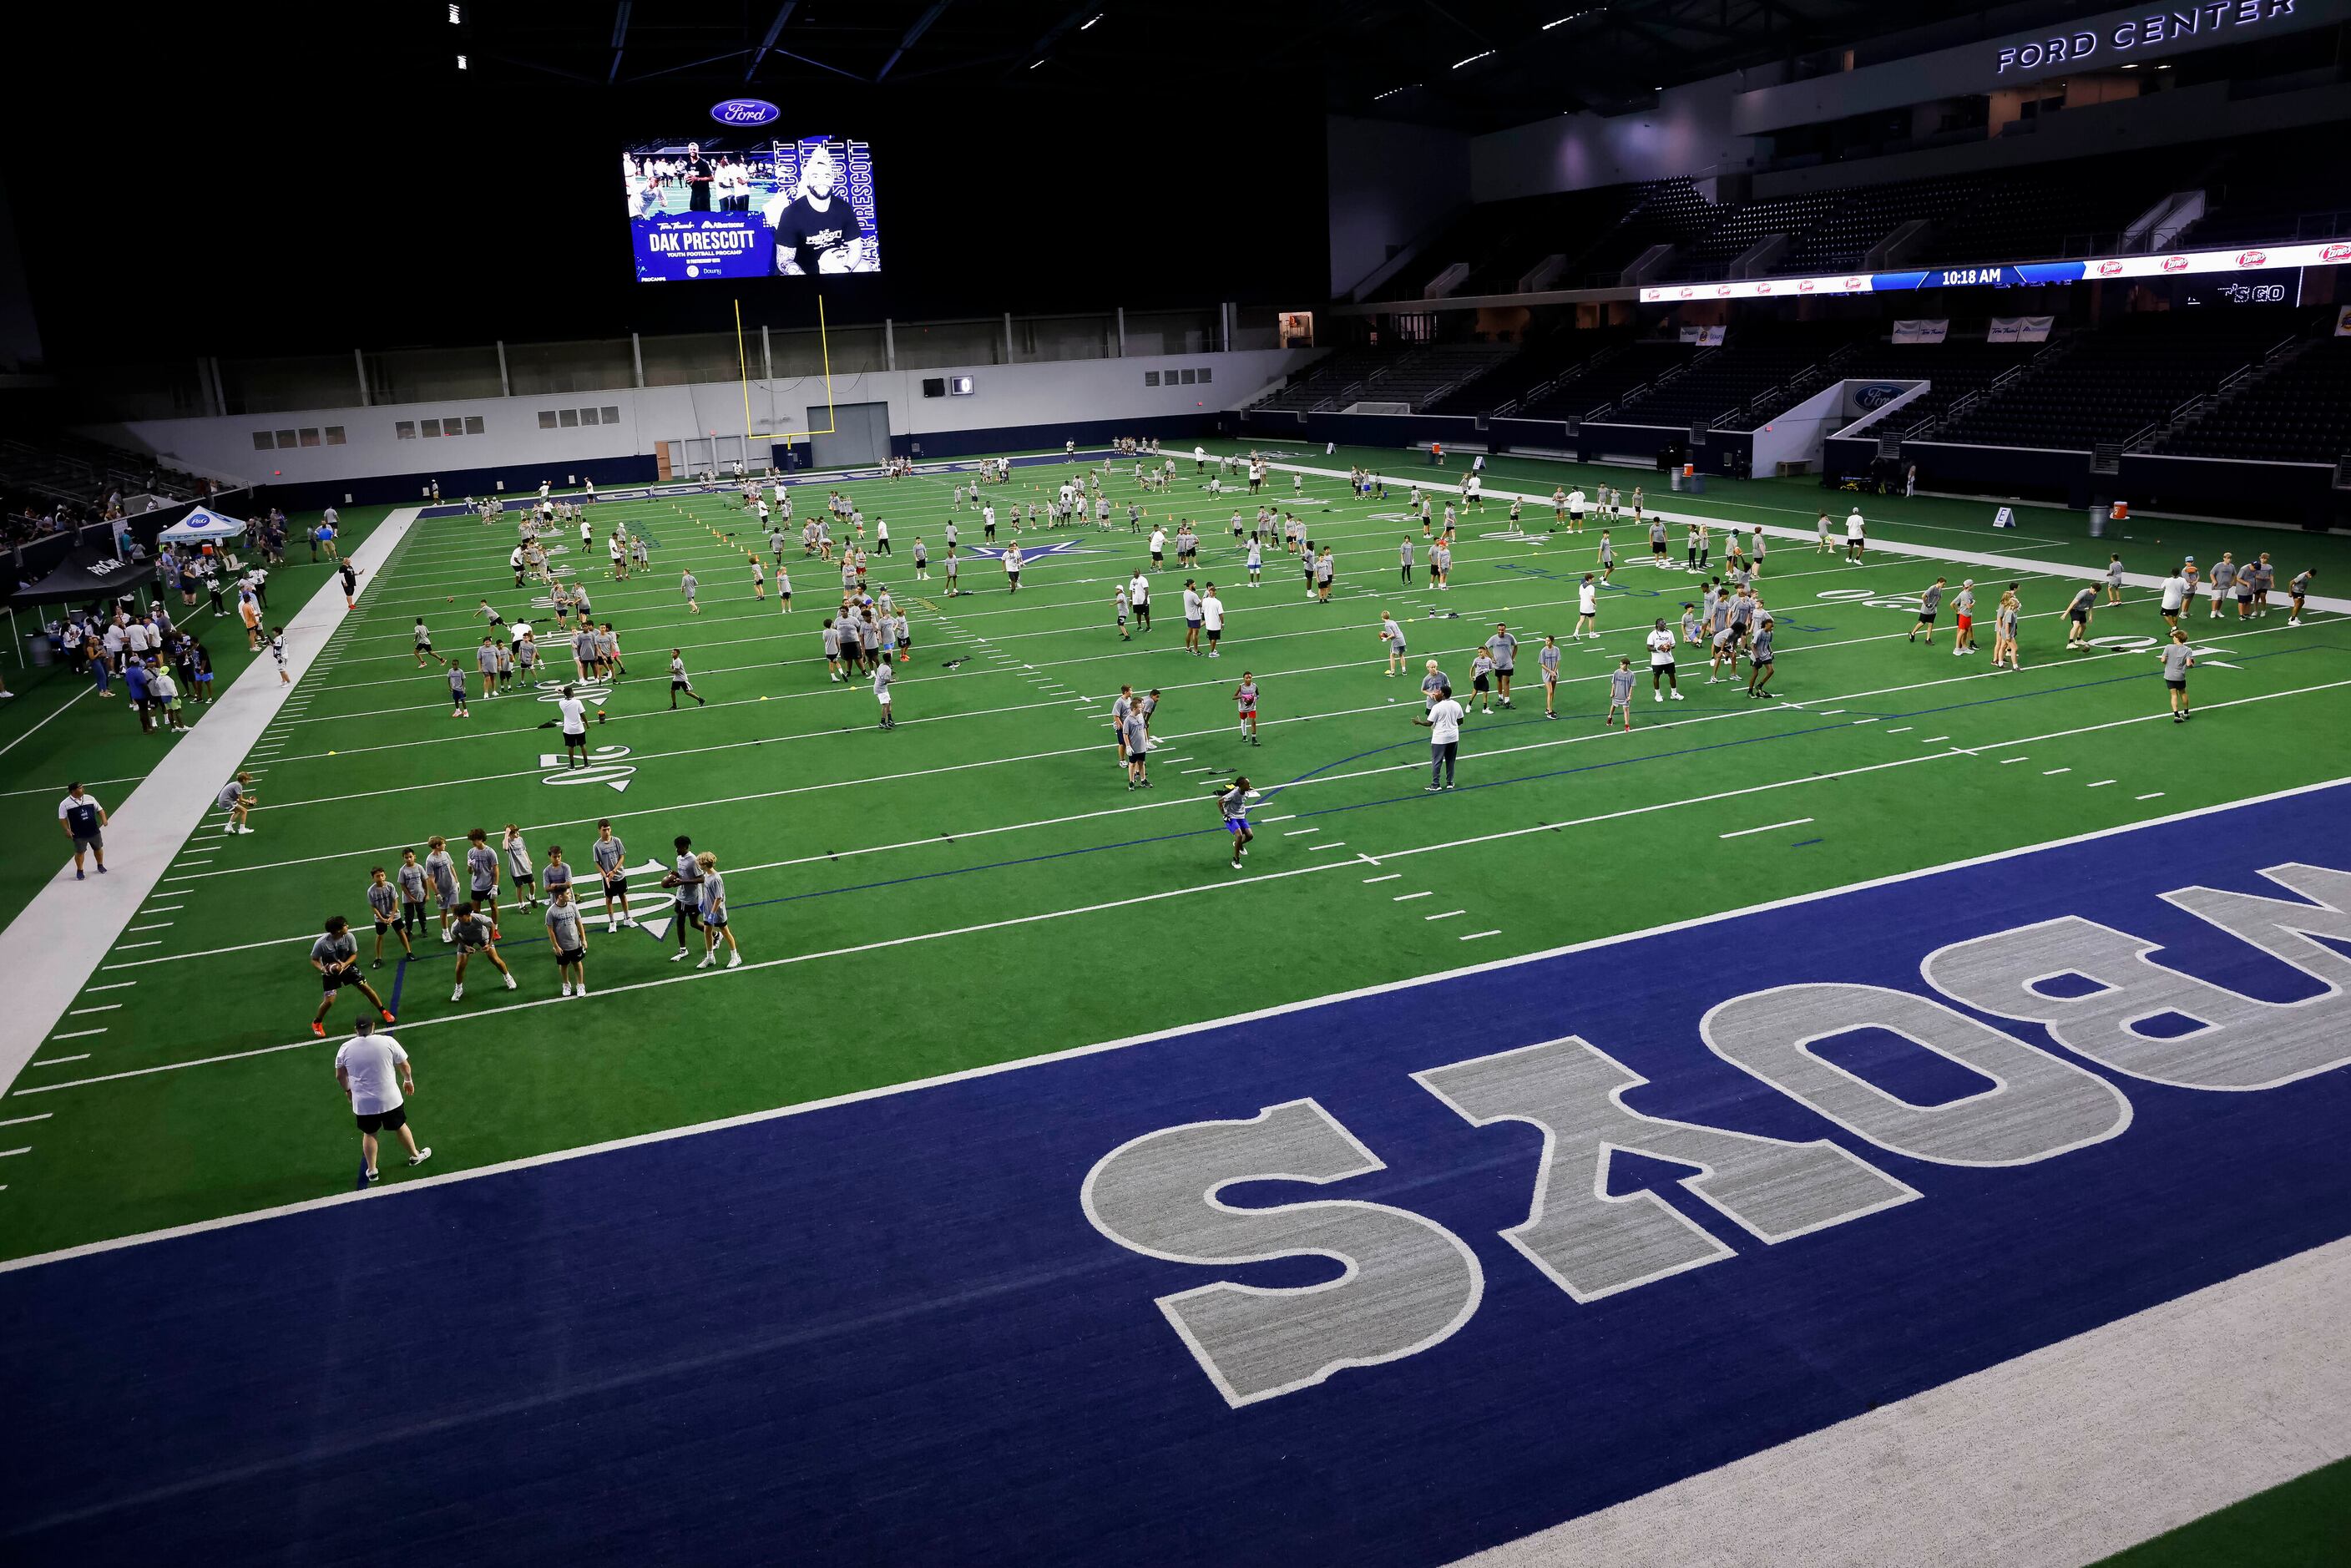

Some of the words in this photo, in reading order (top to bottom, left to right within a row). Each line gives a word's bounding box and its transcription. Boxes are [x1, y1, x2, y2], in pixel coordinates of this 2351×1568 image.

[1995, 32, 2096, 73] FORD
[2110, 0, 2295, 49] CENTER
[725, 103, 766, 122] Ford
[847, 139, 877, 230] PRESCOTT
[649, 233, 680, 252] DAK
[683, 230, 755, 250] PRESCOTT
[1942, 272, 1976, 286] 10:18
[1979, 268, 2001, 283] AM
[2252, 284, 2285, 302] GO
[1998, 508, 2007, 521] E
